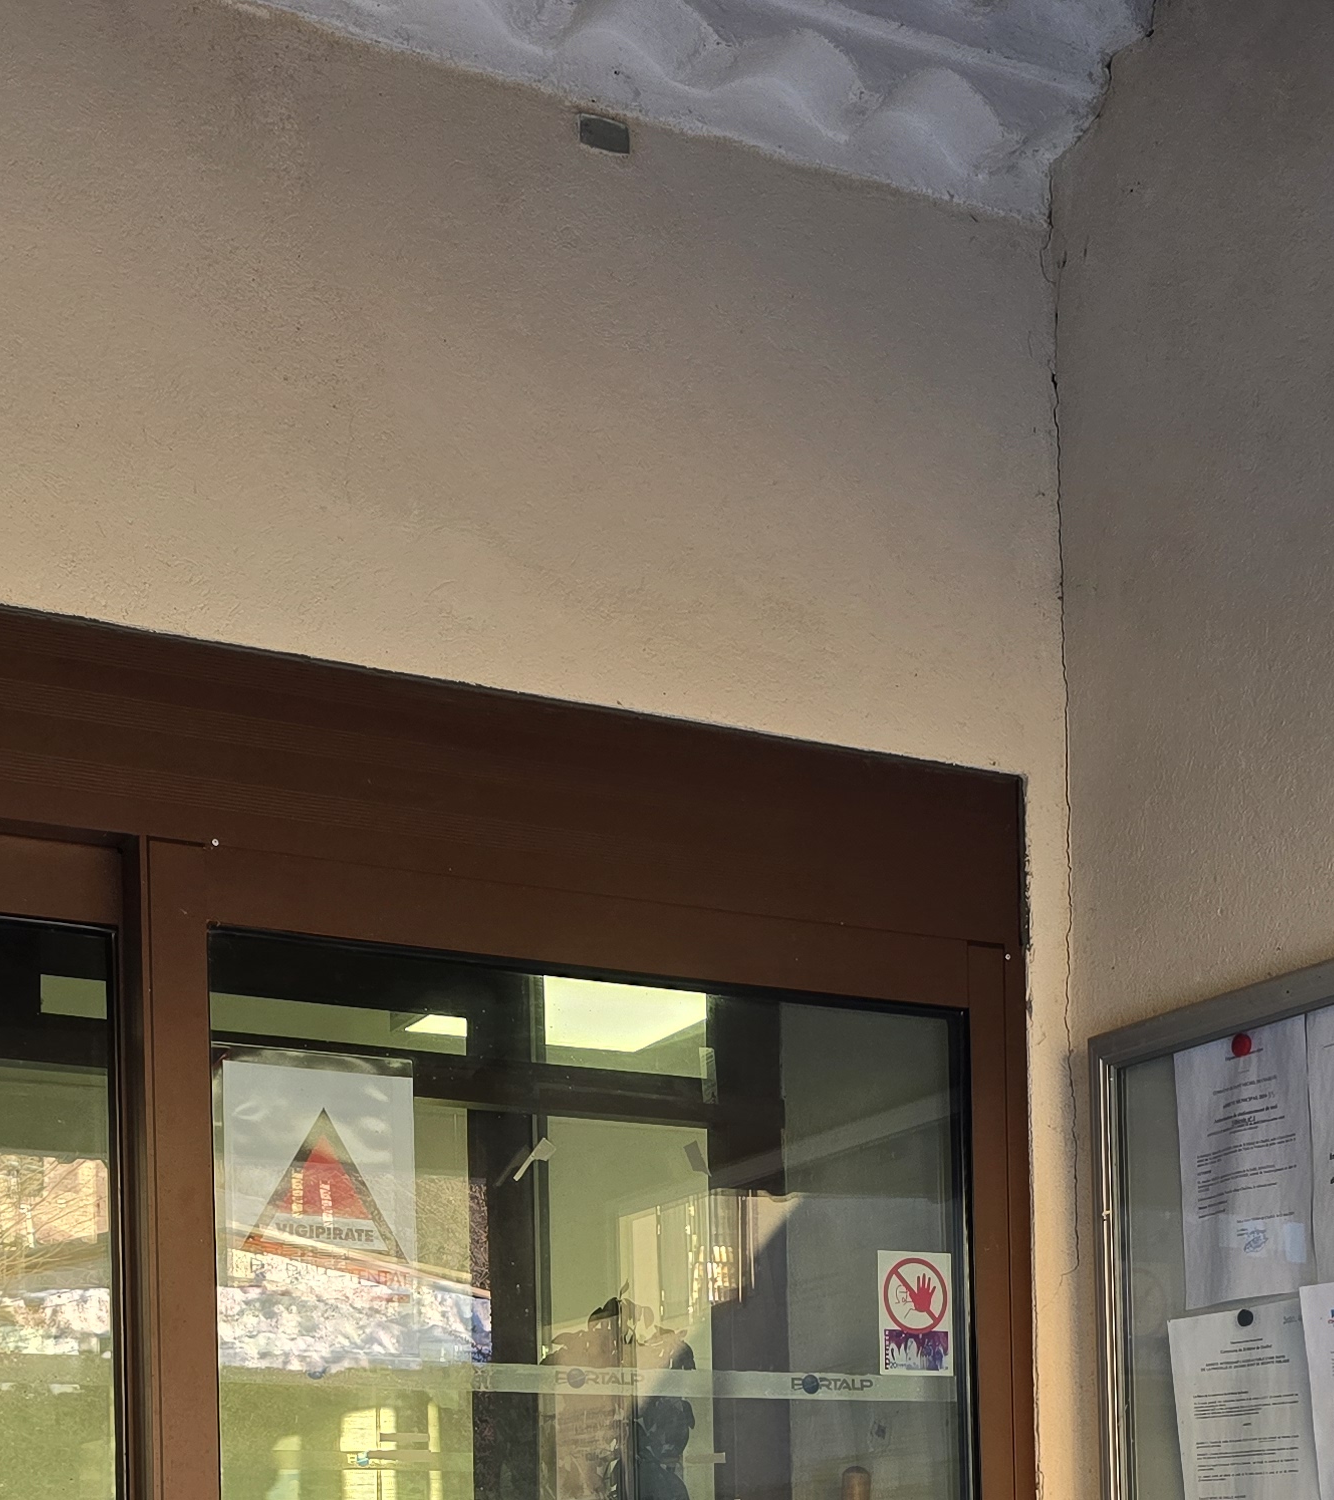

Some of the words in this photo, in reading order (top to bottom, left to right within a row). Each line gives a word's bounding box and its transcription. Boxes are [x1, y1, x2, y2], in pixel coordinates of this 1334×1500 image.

[275, 1223, 374, 1243] VIGIPIRATE
[555, 1368, 644, 1389] PORTALP
[791, 1374, 873, 1394] PORTALP
